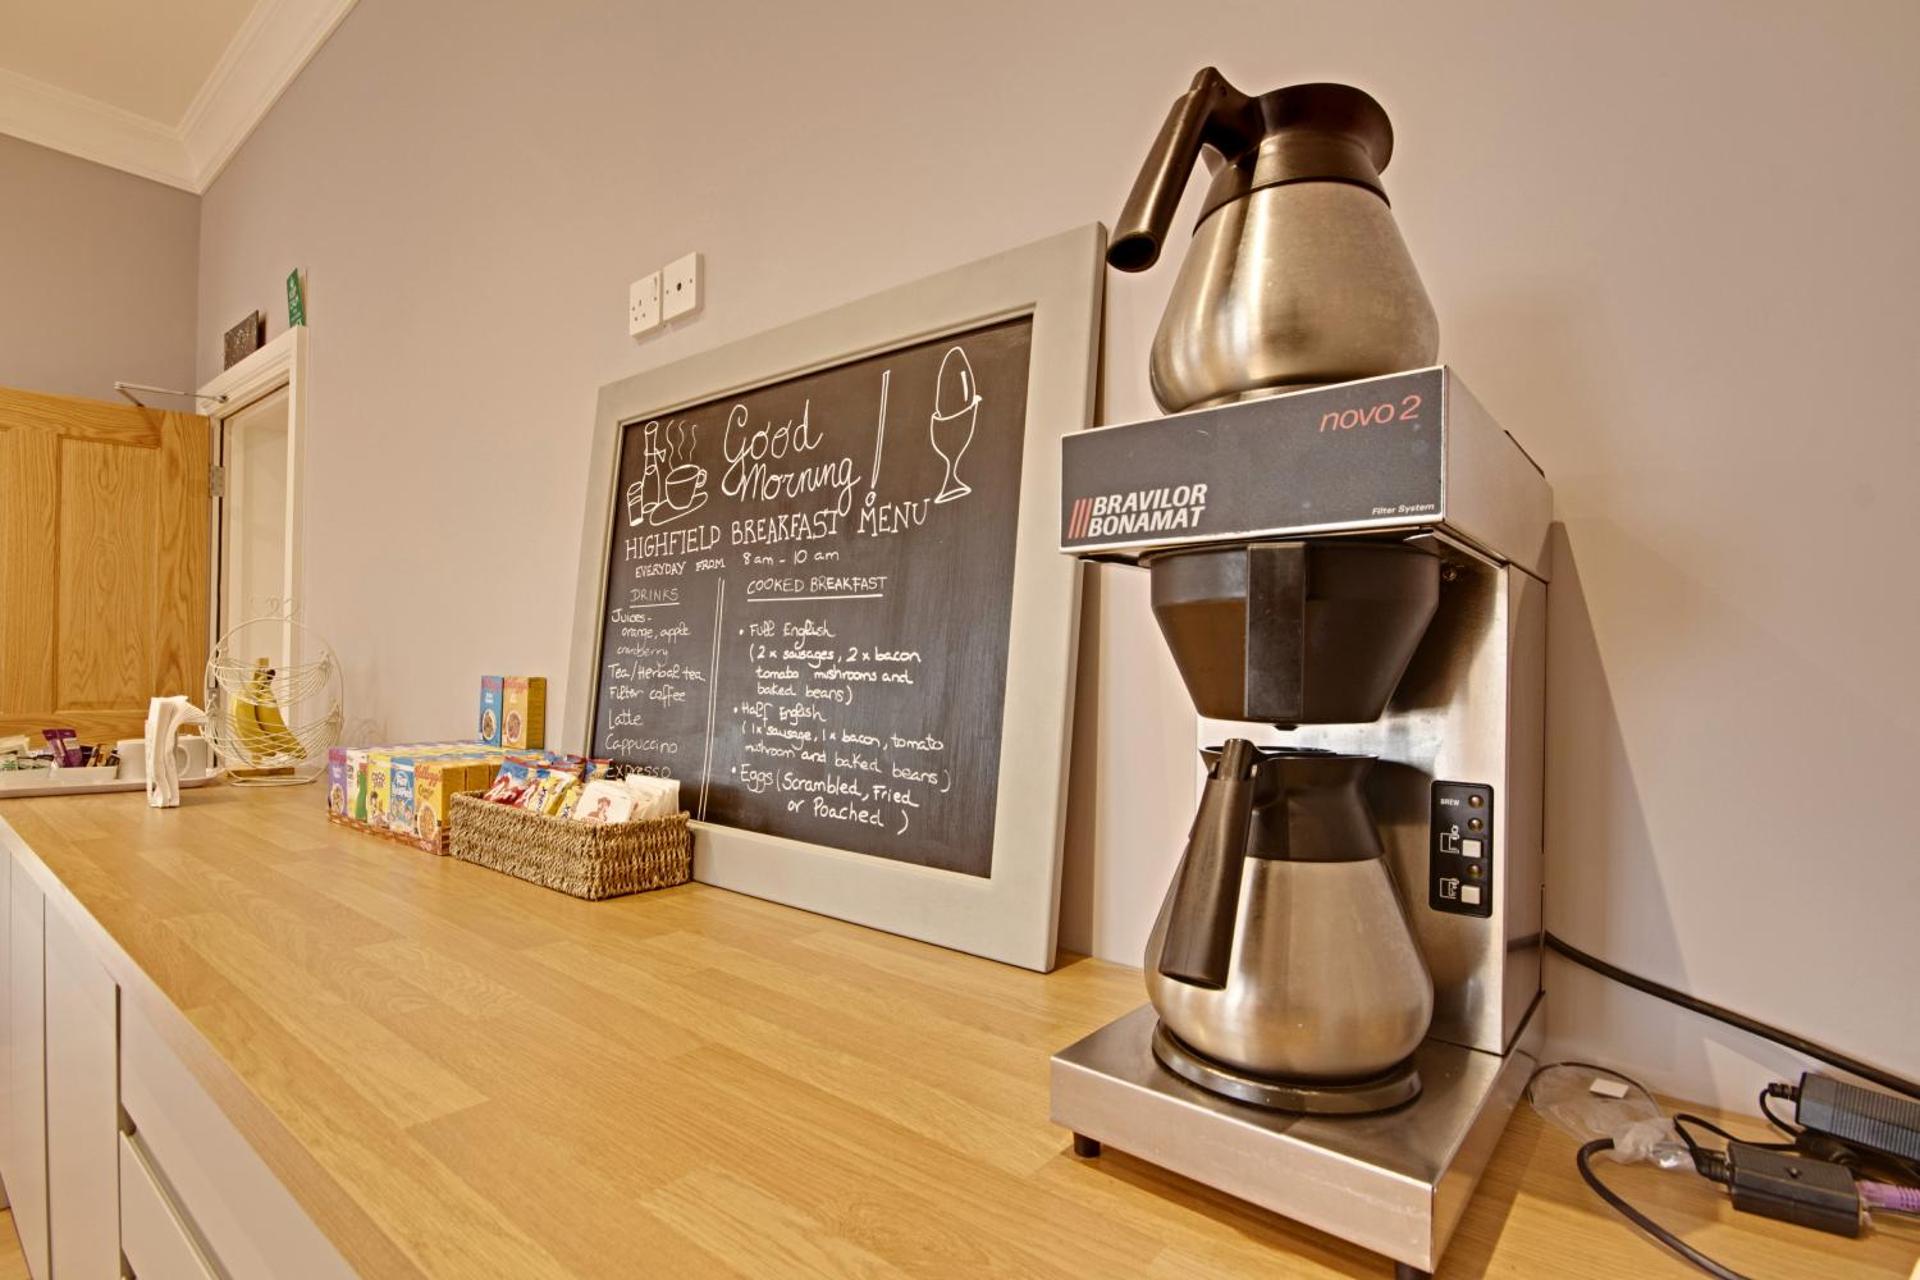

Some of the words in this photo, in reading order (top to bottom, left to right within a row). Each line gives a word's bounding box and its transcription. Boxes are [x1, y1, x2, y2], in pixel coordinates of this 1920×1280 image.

[1319, 403, 1395, 432] novo
[1399, 394, 1422, 421] 2
[724, 400, 824, 464] Good
[722, 458, 861, 517] Morning
[1092, 483, 1208, 517] BRAVILOR
[1087, 505, 1206, 538] BONAMAT
[1371, 507, 1396, 516] Filter
[1398, 503, 1435, 514] System
[625, 525, 721, 561] HIGHFIELD
[731, 508, 839, 546] BREAKFAST
[857, 498, 931, 538] MENU
[635, 561, 687, 579] EVERYDAY
[695, 558, 726, 572] FROM
[629, 588, 679, 602] DRINKS
[747, 578, 805, 595] COOKED
[810, 576, 888, 592] BREAKFAST
[660, 620, 692, 645] apple
[749, 619, 775, 638] Full
[783, 619, 837, 650] English
[874, 646, 922, 664] bacon
[682, 666, 706, 682] tea
[755, 665, 800, 679] tomato
[813, 664, 877, 682] mushrooms
[881, 670, 914, 685] and
[609, 684, 644, 700] Filter
[649, 684, 687, 709] coffee
[757, 681, 797, 697] baked
[608, 707, 643, 730] Latte
[741, 701, 773, 728] Half
[779, 704, 827, 726] English
[604, 732, 678, 757] Cappuccino
[891, 732, 945, 751] tomato
[801, 749, 827, 764] and
[740, 762, 774, 794] Eggs
[871, 784, 919, 808] Fried
[787, 799, 804, 813] or
[812, 796, 885, 828] Poached
[1440, 798, 1460, 807] BREW
